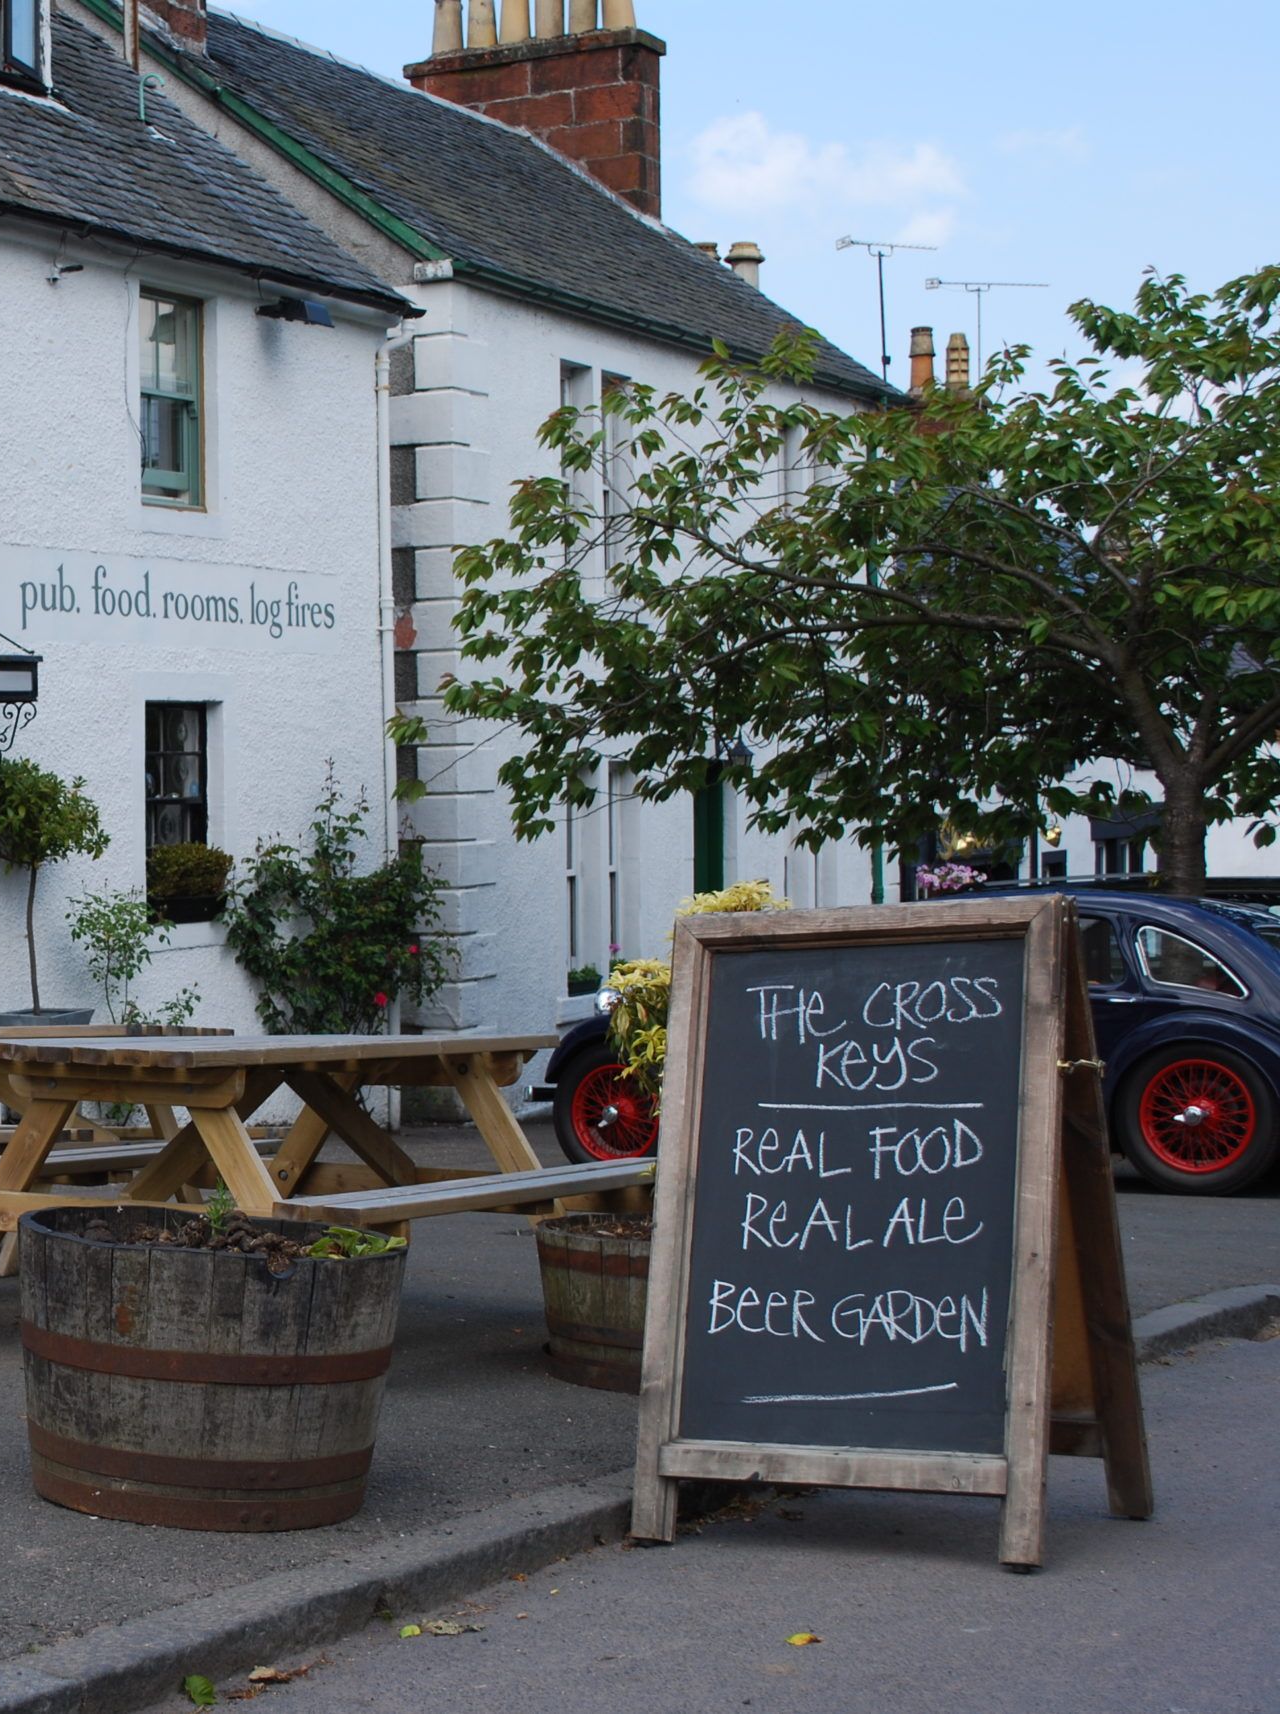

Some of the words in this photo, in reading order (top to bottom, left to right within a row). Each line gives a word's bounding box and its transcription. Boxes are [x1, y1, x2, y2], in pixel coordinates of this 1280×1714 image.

[19, 562, 81, 631] pub.
[91, 564, 157, 619] food.
[162, 591, 244, 625] rooms.
[862, 976, 1004, 1031] CROSS
[868, 1118, 985, 1180] FOOD
